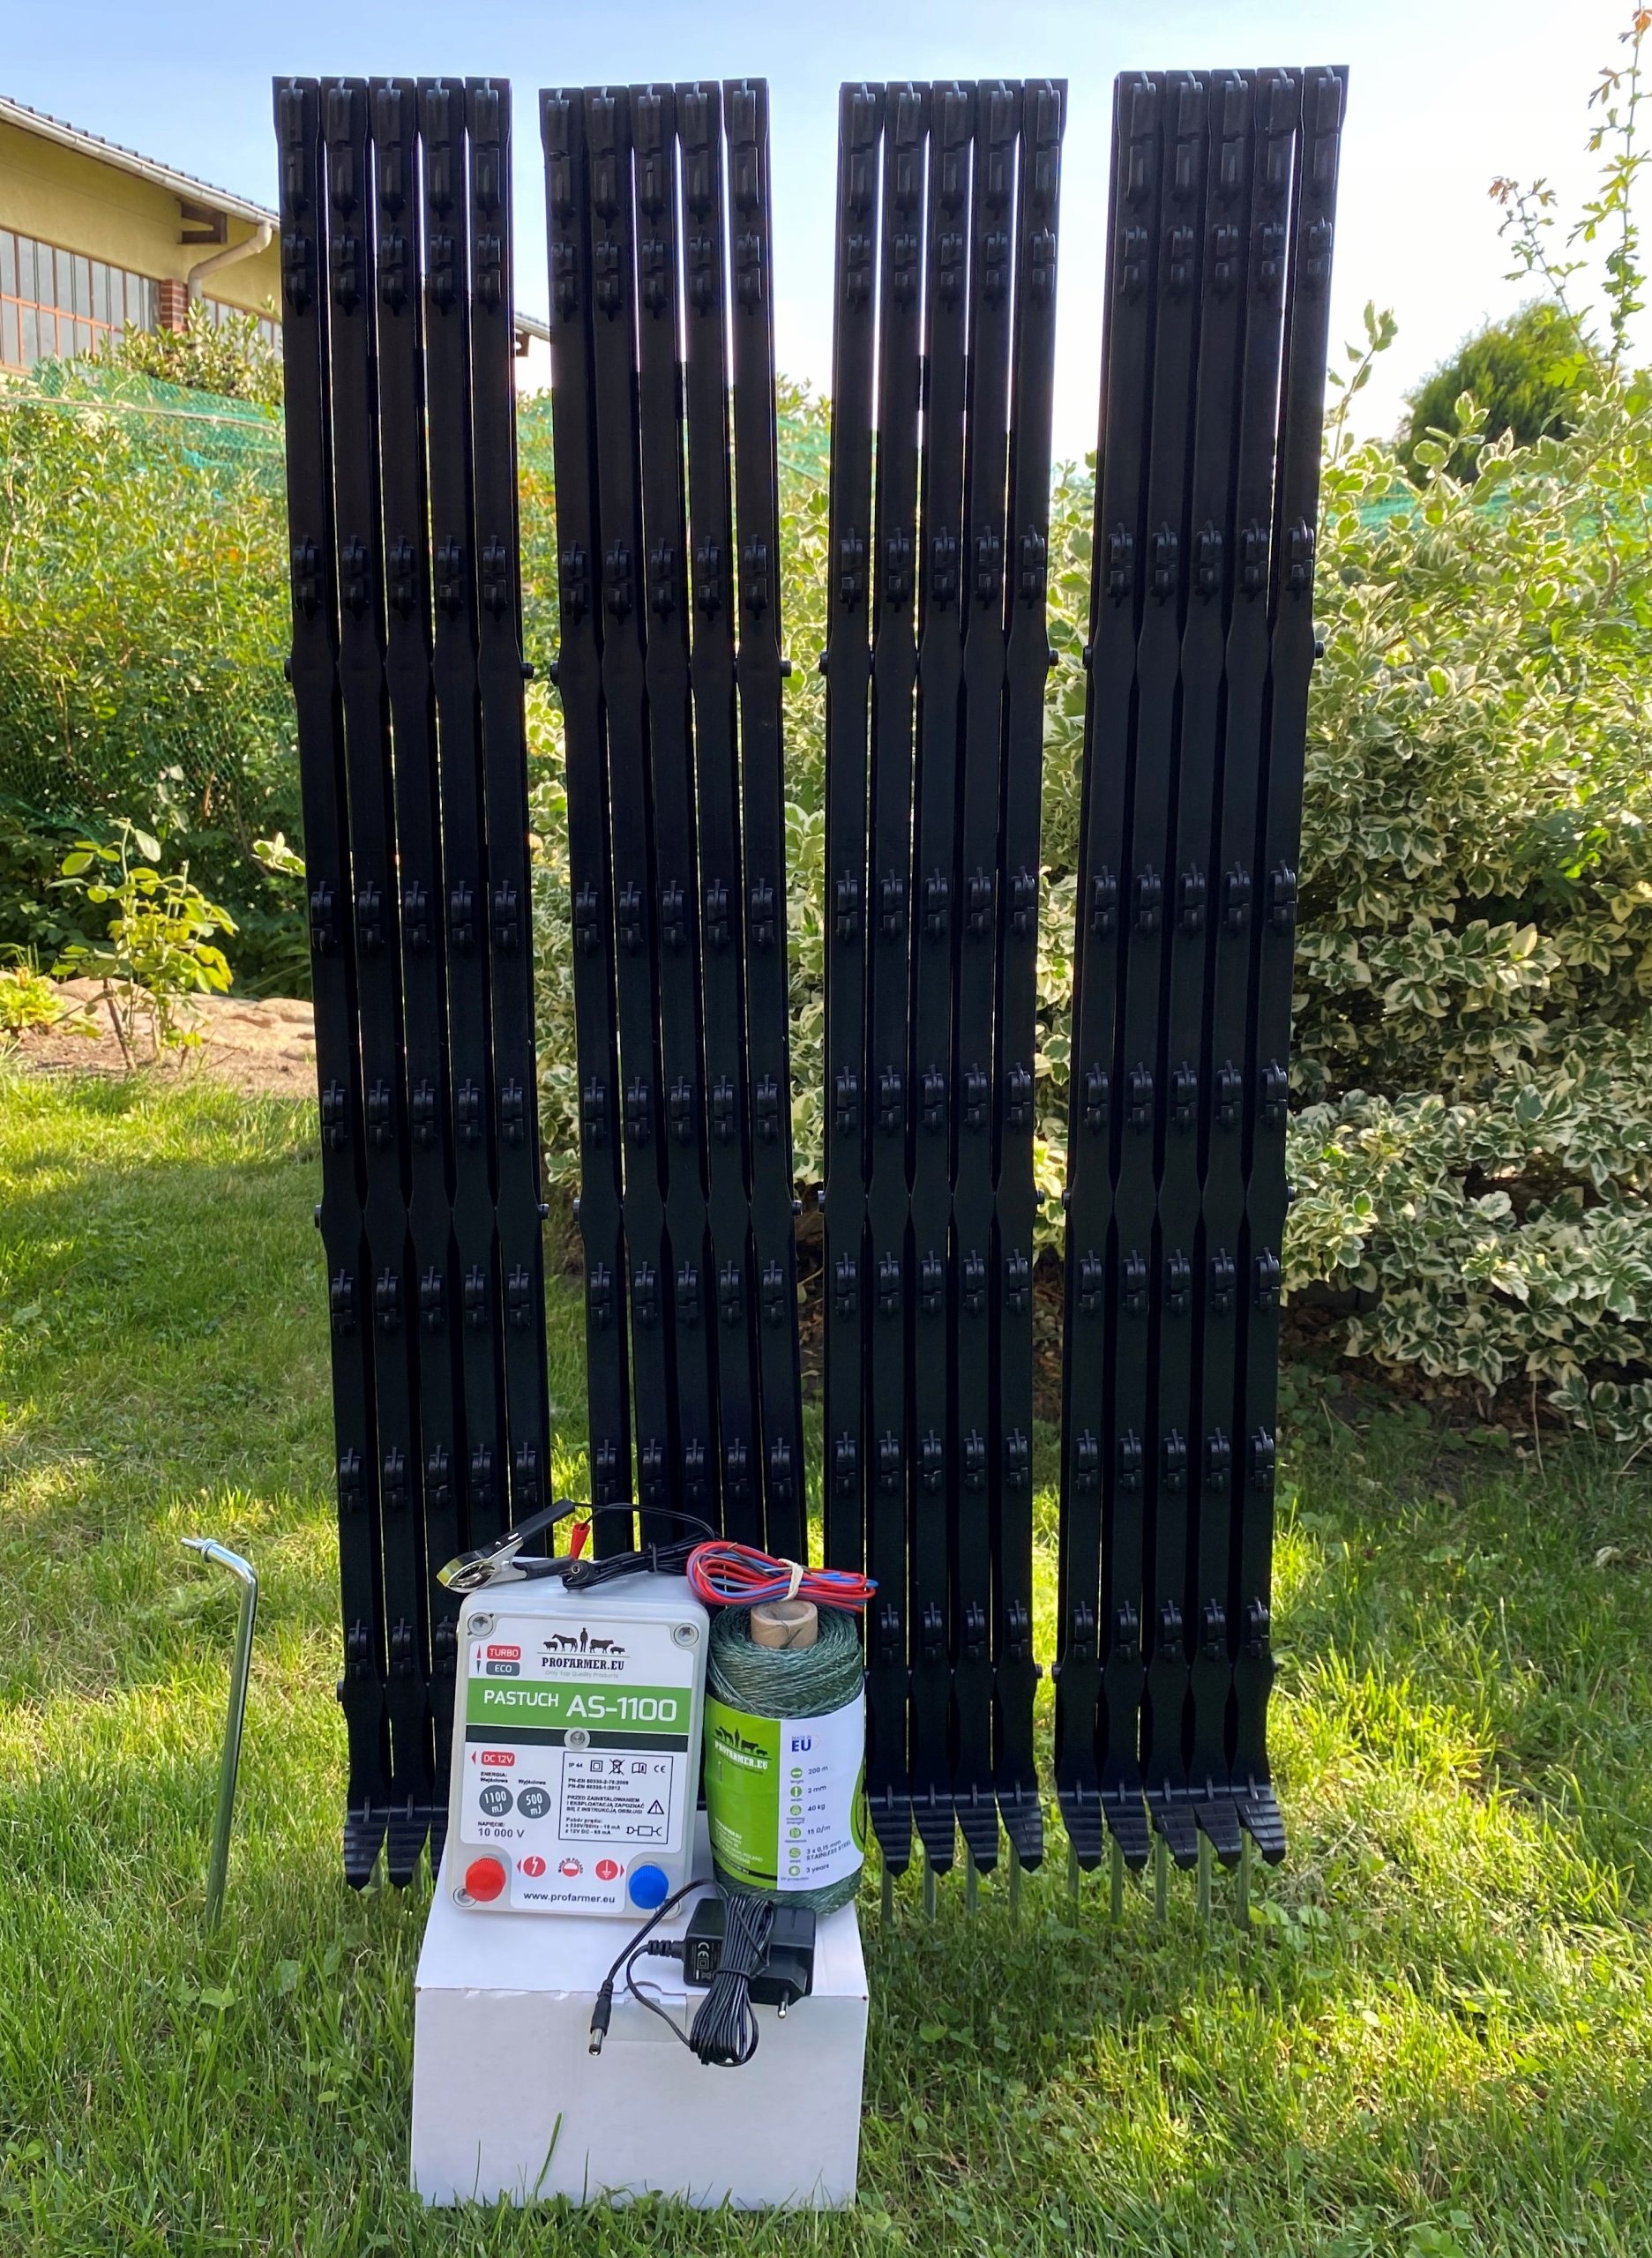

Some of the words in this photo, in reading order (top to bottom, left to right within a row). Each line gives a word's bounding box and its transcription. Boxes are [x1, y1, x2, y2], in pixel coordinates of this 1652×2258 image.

[490, 1648, 519, 1657] TURBO
[494, 1664, 512, 1673] ECO
[542, 1657, 624, 1671] PROFARMER.EU
[483, 1689, 559, 1708] PASTUCH
[565, 1694, 677, 1722] AS-1100
[791, 1739, 811, 1752] EU
[483, 1754, 496, 1763] DC
[497, 1754, 513, 1763] 12V
[714, 1740, 768, 1770] PROFARMER.EU
[484, 1791, 507, 1804] 1100
[526, 1793, 542, 1806] 500
[491, 1803, 503, 1813] mJ
[530, 1805, 542, 1815] mJ
[478, 1828, 490, 1836] 10
[494, 1828, 513, 1838] 000
[517, 1829, 525, 1838] V
[830, 1840, 841, 1848] mm
[806, 1848, 837, 1861] STAINLESS
[838, 1840, 852, 1851] STEEL
[811, 1864, 830, 1874] years
[523, 1892, 616, 1903] www.profarmer.eu
